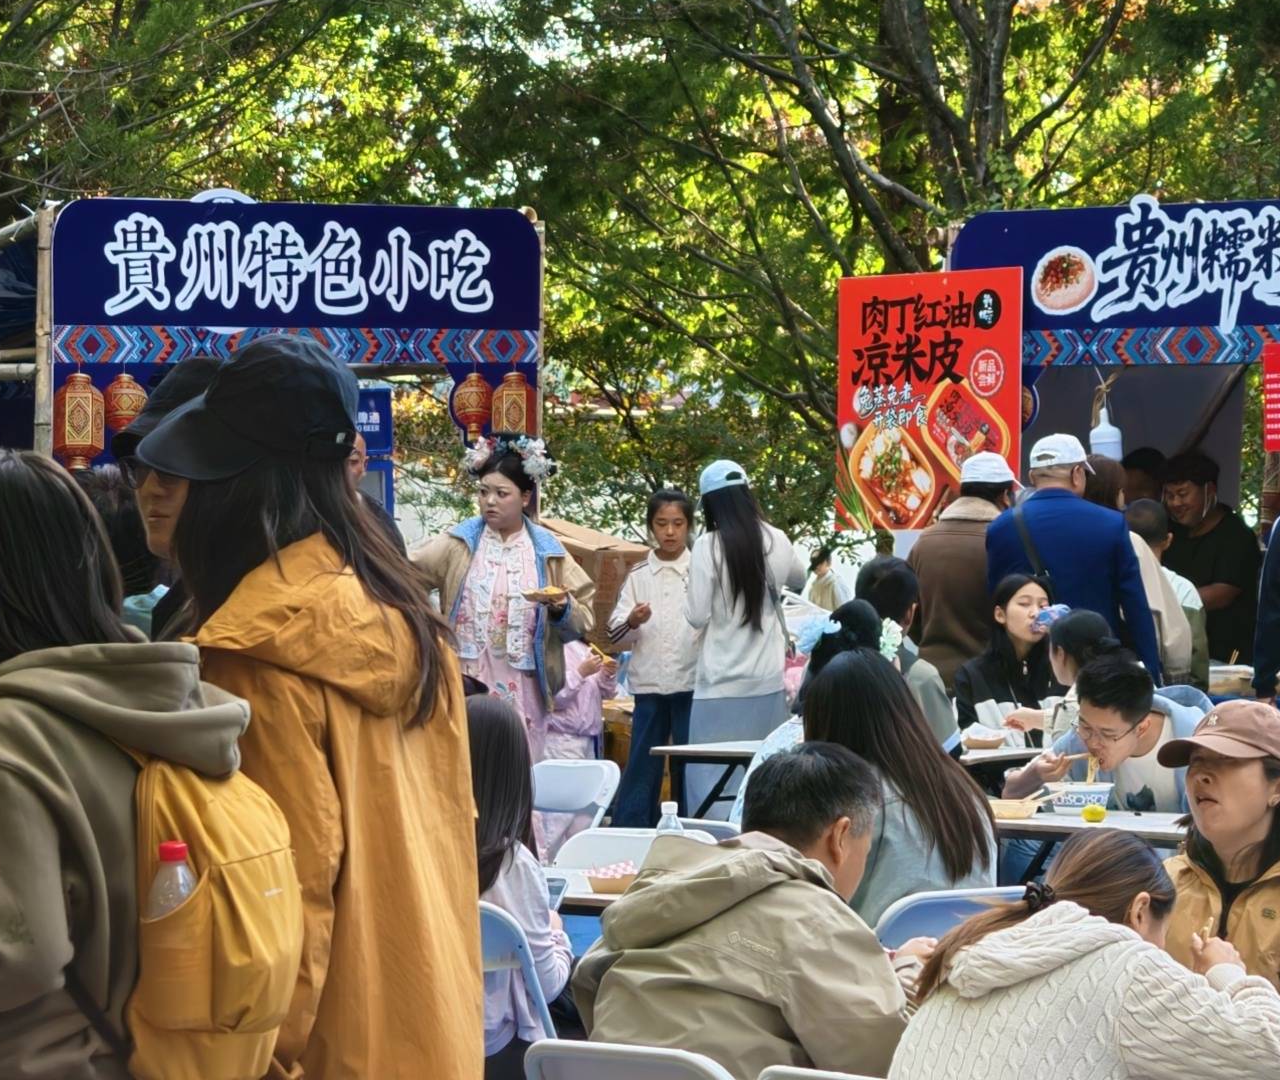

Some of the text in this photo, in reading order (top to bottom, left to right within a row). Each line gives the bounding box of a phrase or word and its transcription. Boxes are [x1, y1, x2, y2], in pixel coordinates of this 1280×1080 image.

[106, 213, 493, 315] 貴州特色小吃
[860, 290, 974, 338] 肉丁红油
[851, 330, 966, 386] 凉米皮
